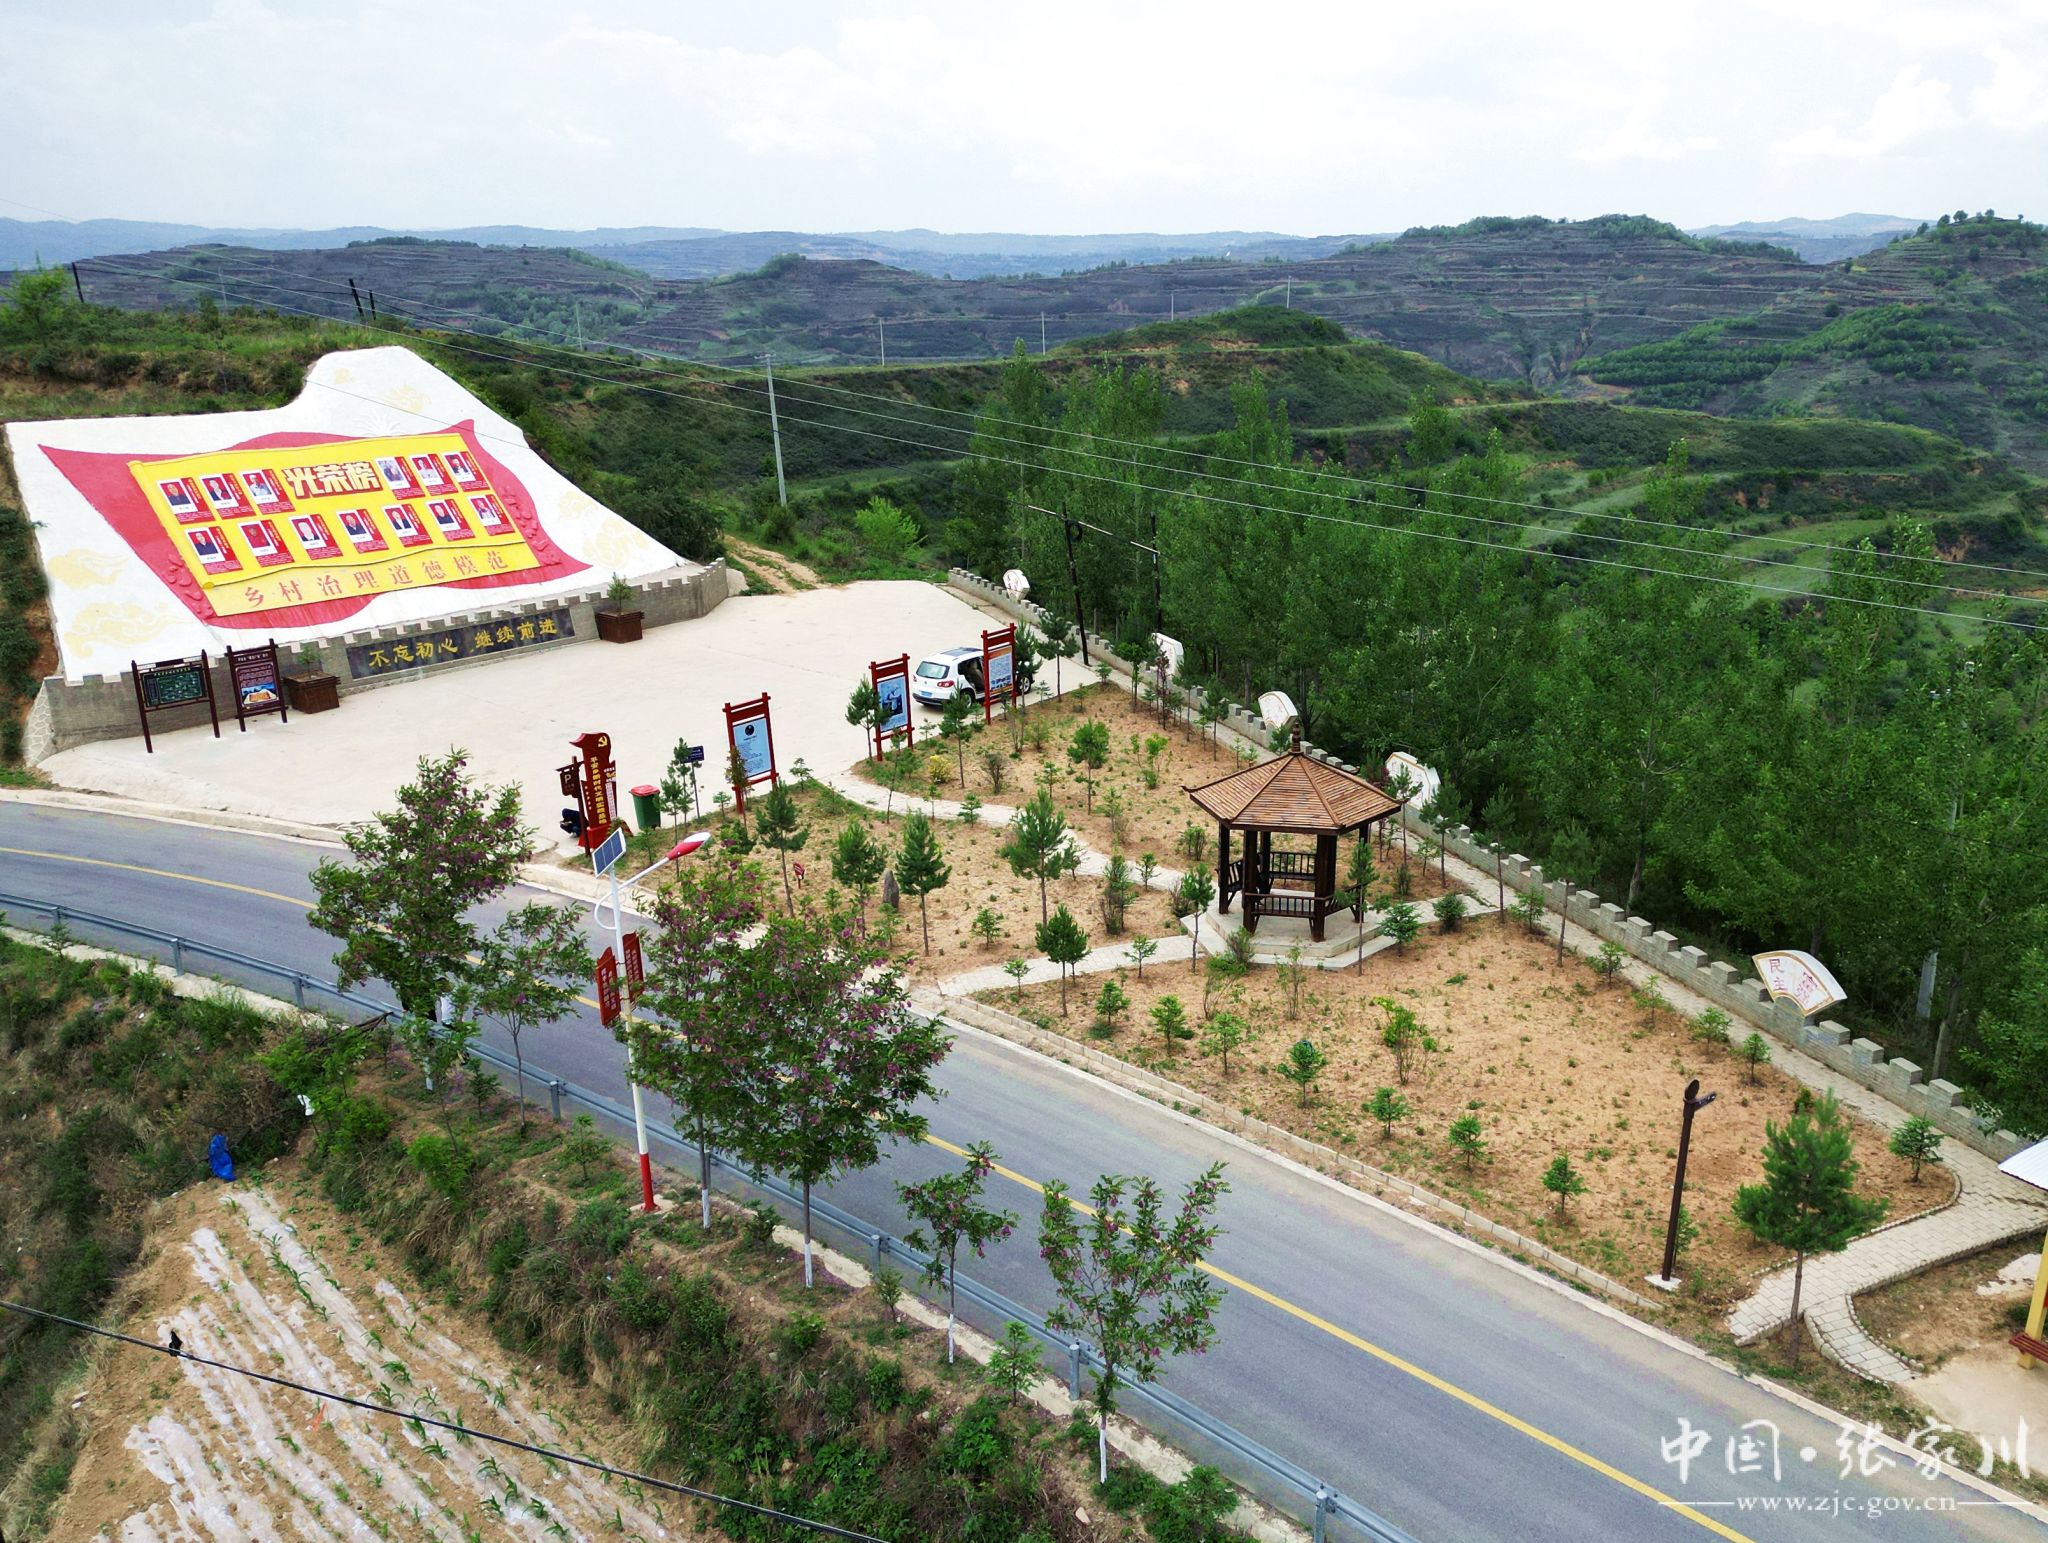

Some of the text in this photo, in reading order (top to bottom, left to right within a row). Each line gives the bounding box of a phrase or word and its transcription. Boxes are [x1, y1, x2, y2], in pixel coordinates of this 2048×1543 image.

[283, 461, 382, 498] 光荣榜
[245, 551, 508, 607] 乡村治理道德模范
